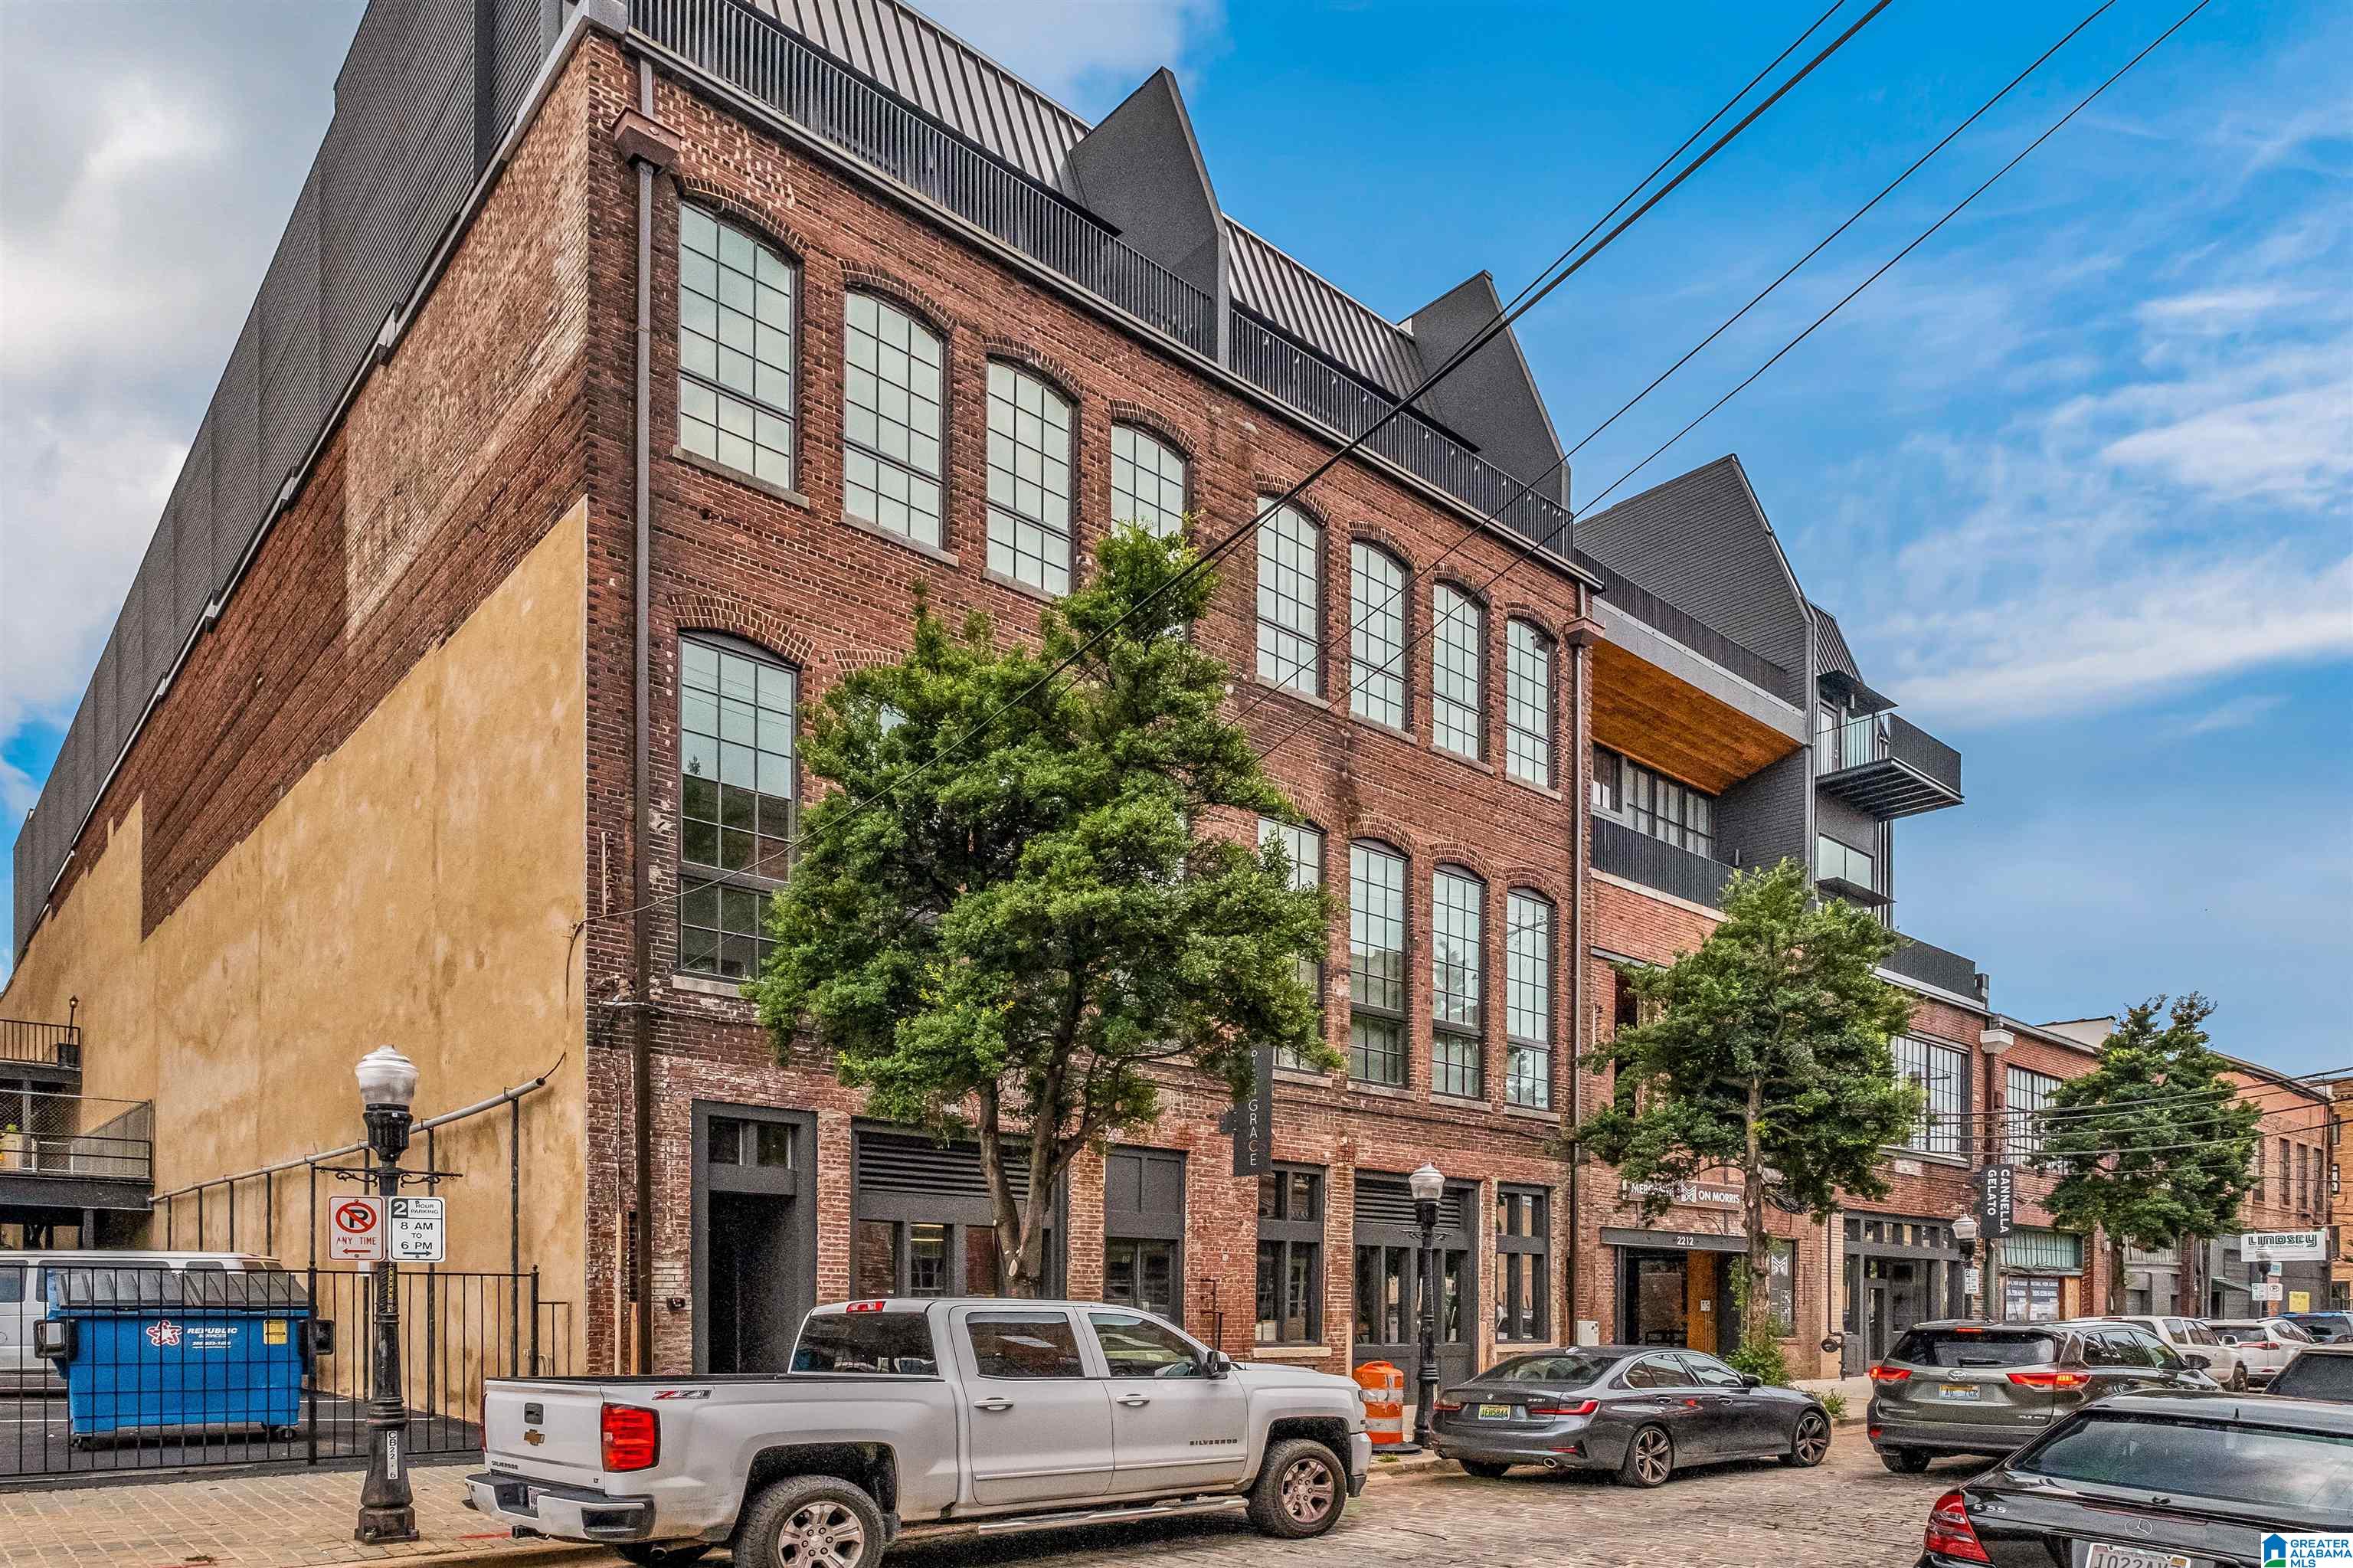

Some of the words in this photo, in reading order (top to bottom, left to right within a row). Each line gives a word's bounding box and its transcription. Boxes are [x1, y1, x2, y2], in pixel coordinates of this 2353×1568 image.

[1248, 1099, 1258, 1166] GRACE
[1698, 1190, 1710, 1201] ON
[1712, 1192, 1740, 1203] MORRIS
[1987, 1169, 1997, 1216] GELATO
[2000, 1169, 2010, 1233] CANNELLA
[394, 1201, 407, 1216] 2
[401, 1222, 408, 1230] 8
[401, 1242, 409, 1250] 6
[414, 1242, 433, 1250] PM
[1677, 1236, 1694, 1246] 2212
